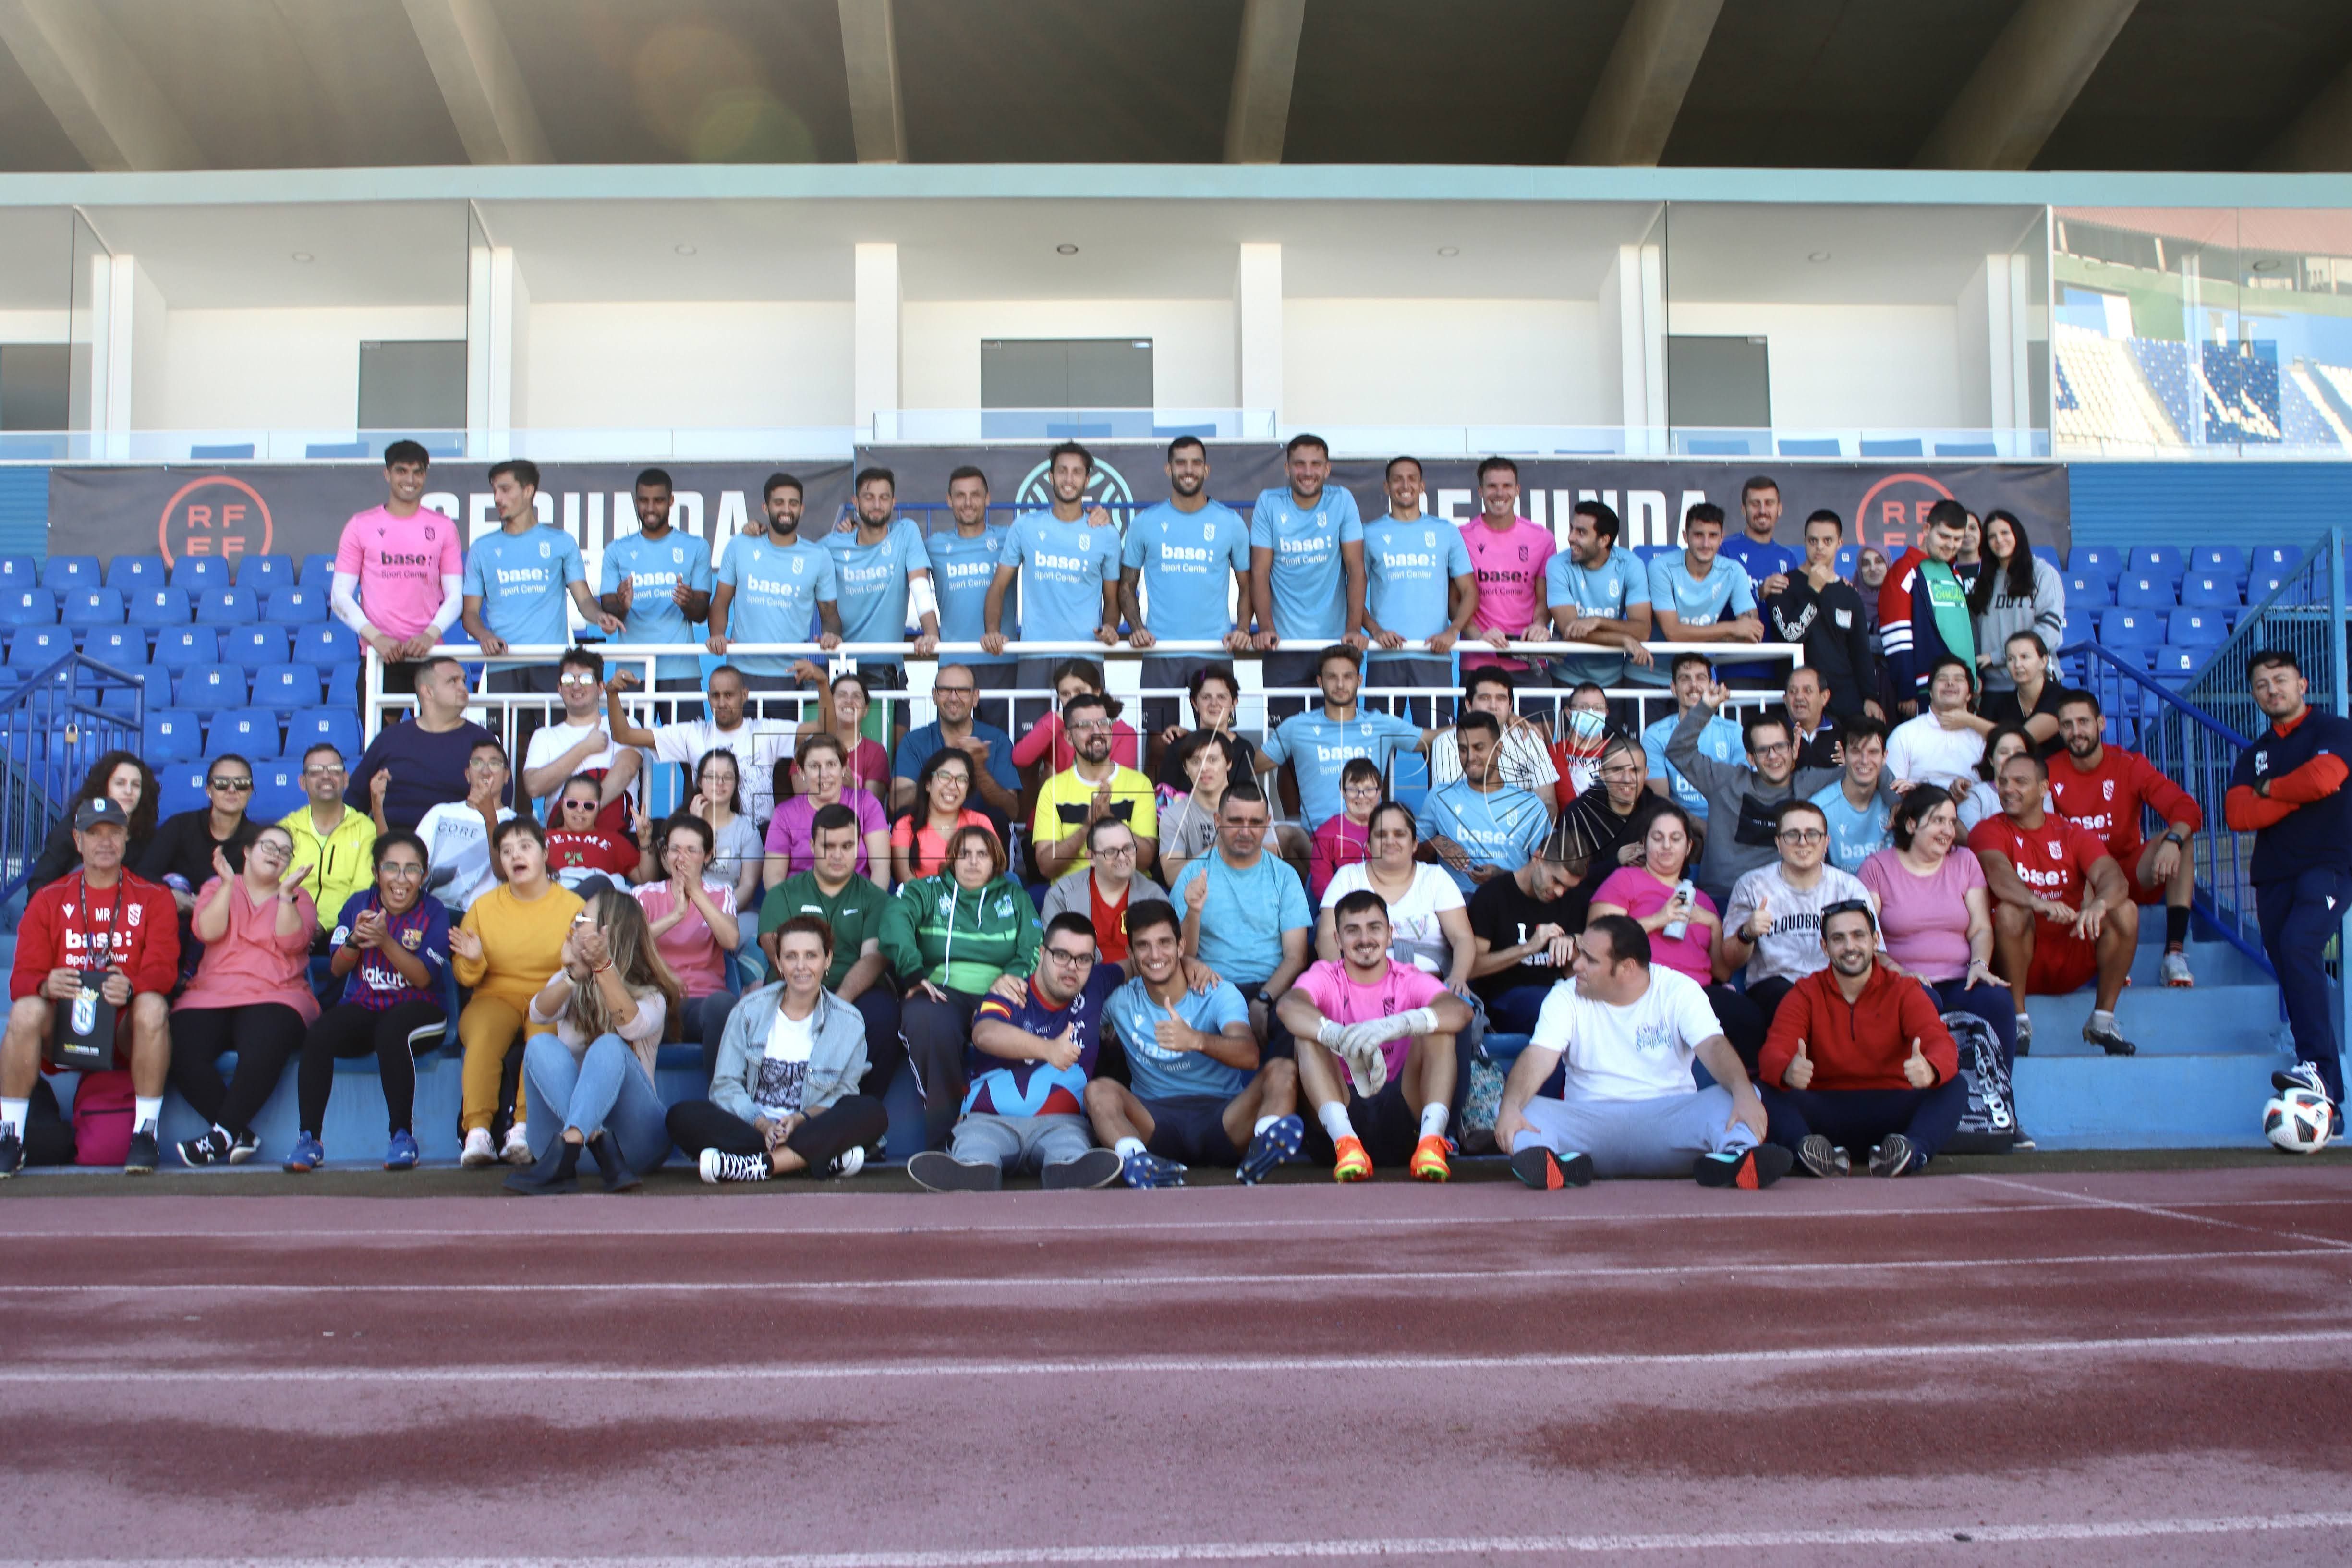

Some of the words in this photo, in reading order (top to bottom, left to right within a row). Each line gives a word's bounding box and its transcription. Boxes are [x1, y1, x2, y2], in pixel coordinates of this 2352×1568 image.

[1280, 535, 1332, 553] base:
[381, 550, 432, 566] base:
[1162, 542, 1213, 562] base:
[1280, 556, 1300, 567] Sport
[1302, 552, 1328, 564] Center
[1035, 550, 1088, 572] base:
[1161, 562, 1180, 573] Sport
[1182, 564, 1208, 573] Center
[1383, 552, 1437, 569] base:
[381, 569, 405, 579] Sport
[407, 571, 427, 579] Center
[497, 567, 549, 584] base:
[843, 564, 894, 582] base:
[1034, 571, 1055, 582] Sport
[1055, 572, 1080, 584] Center
[1406, 570, 1432, 580] Center
[1478, 569, 1528, 583] base:
[499, 586, 520, 597] Sport
[521, 583, 546, 594] Center
[747, 574, 800, 597] base:
[845, 584, 865, 596] Sport
[948, 580, 966, 591] Sport
[968, 579, 993, 589] Cente
[1478, 587, 1498, 596] Sport
[1499, 588, 1523, 596] Center
[654, 589, 674, 599] Cent
[746, 595, 765, 607] Sport
[766, 597, 793, 609] Center
[1457, 824, 1514, 846] base:
[95, 907, 110, 922] MR
[362, 964, 410, 990] Rakut
